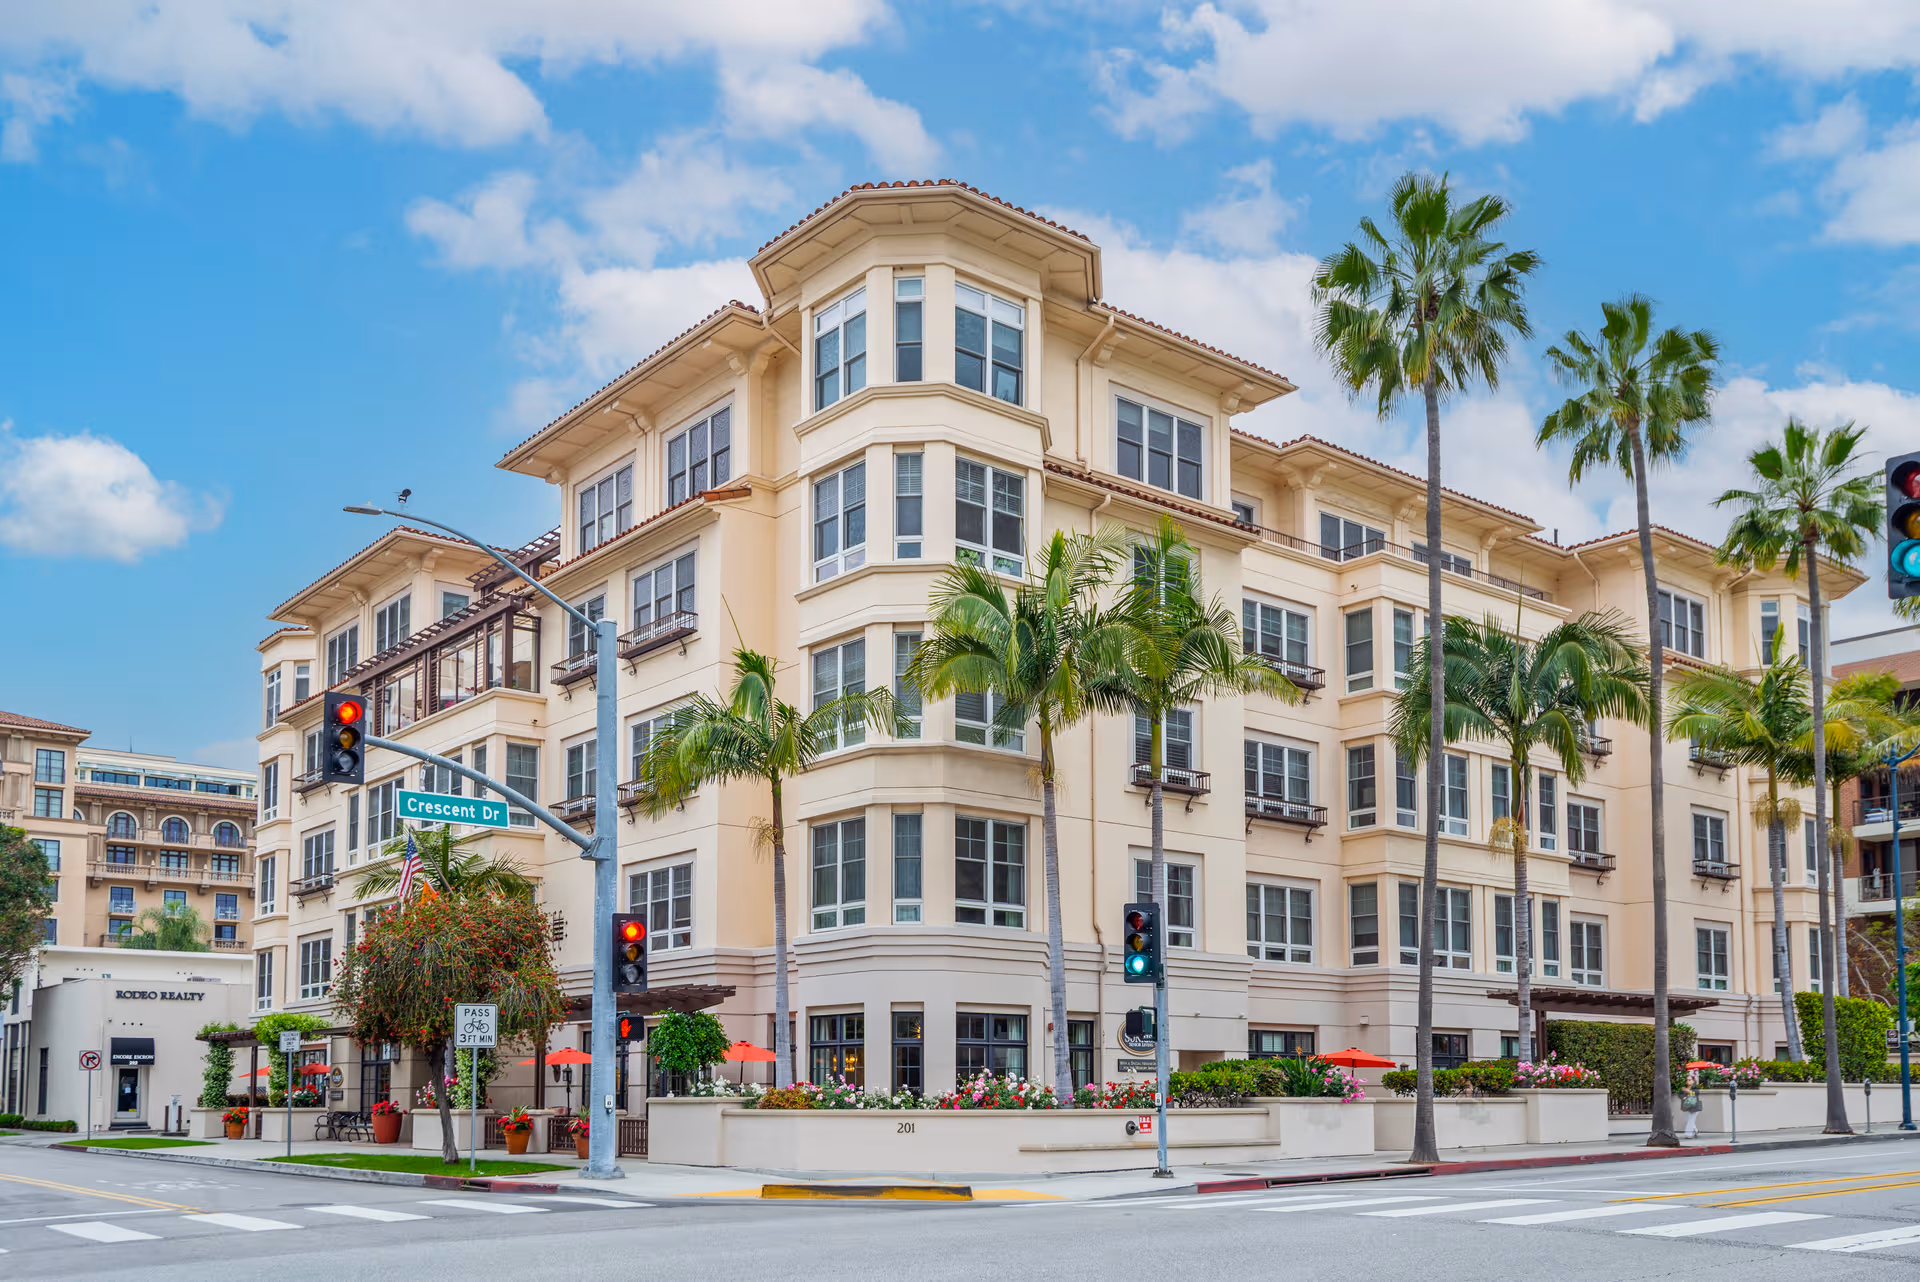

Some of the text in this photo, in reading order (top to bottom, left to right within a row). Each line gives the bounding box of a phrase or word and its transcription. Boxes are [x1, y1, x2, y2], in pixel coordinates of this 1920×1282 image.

[407, 797, 500, 821] Crescent Dr
[116, 990, 205, 1002] RODEO REALTY
[464, 1008, 490, 1017] PASS
[480, 1034, 493, 1043] MIN
[896, 1122, 915, 1134] 201
